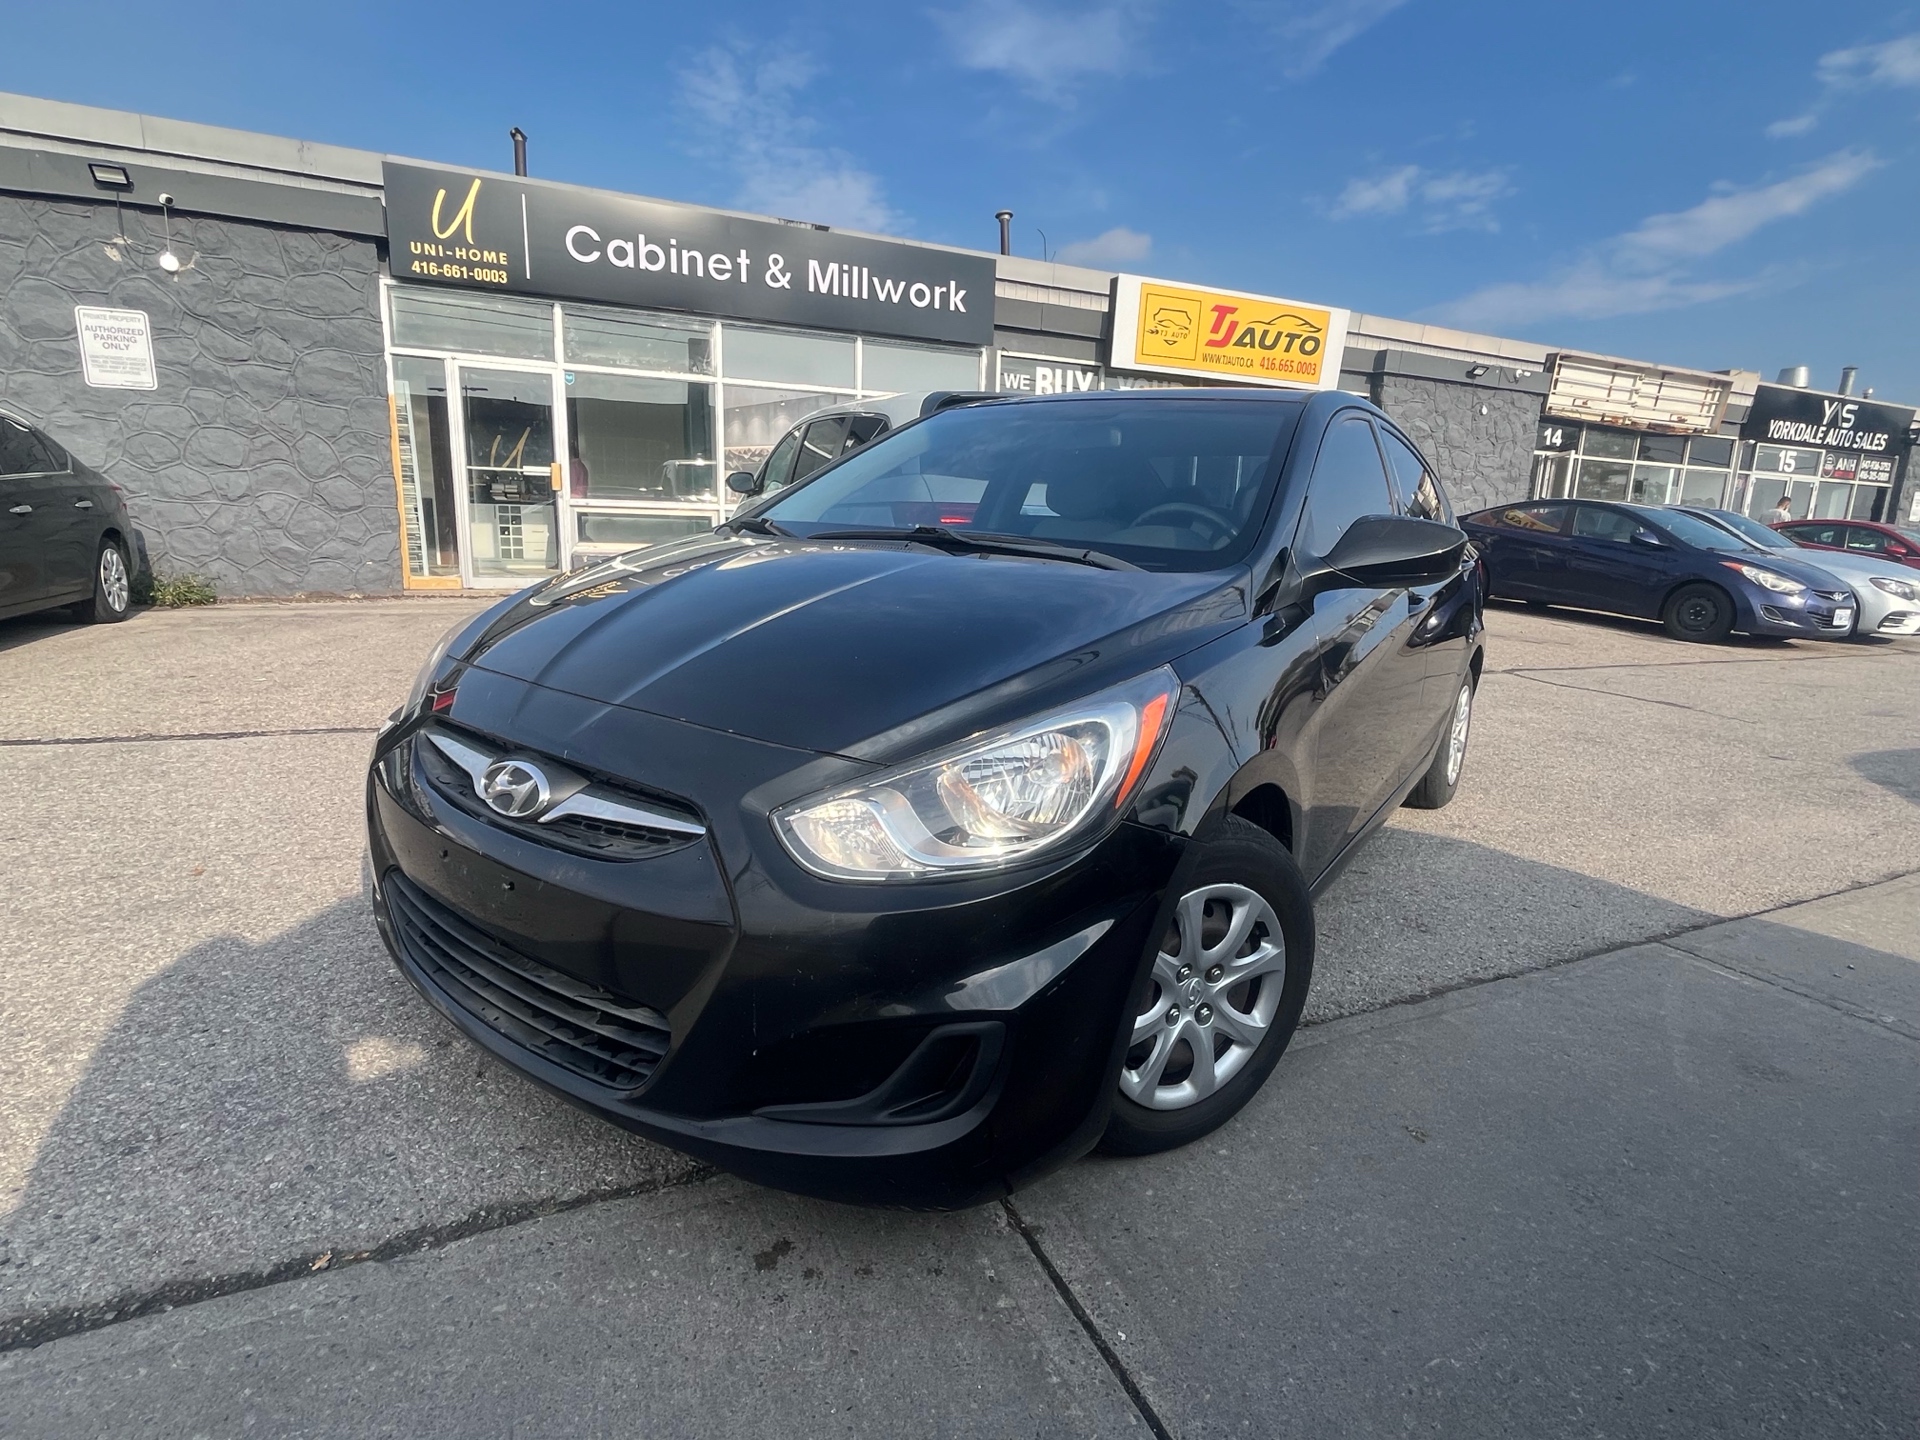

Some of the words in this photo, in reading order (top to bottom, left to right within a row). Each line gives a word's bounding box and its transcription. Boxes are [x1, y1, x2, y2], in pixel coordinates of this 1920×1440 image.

[410, 241, 508, 265] UNI-HOME
[411, 260, 508, 284] 416-661-0003
[564, 225, 750, 283] Cabinet
[764, 253, 792, 290] &
[808, 259, 968, 313] Millwork
[84, 324, 145, 336] AUTHORIZED
[93, 333, 138, 344] PARKING
[1171, 331, 1188, 340] AUTO
[102, 342, 130, 351] ONLY
[1202, 352, 1254, 369] WWW.TJAUTO.CA
[1259, 356, 1317, 376] 416.665.0003
[1003, 372, 1031, 391] WE
[1035, 366, 1095, 396] BUY
[1543, 427, 1563, 447] 14
[1767, 419, 1827, 445] YORKDALE
[1824, 427, 1854, 447] AUTO
[1852, 431, 1889, 451] SALES
[1778, 450, 1798, 473] 15
